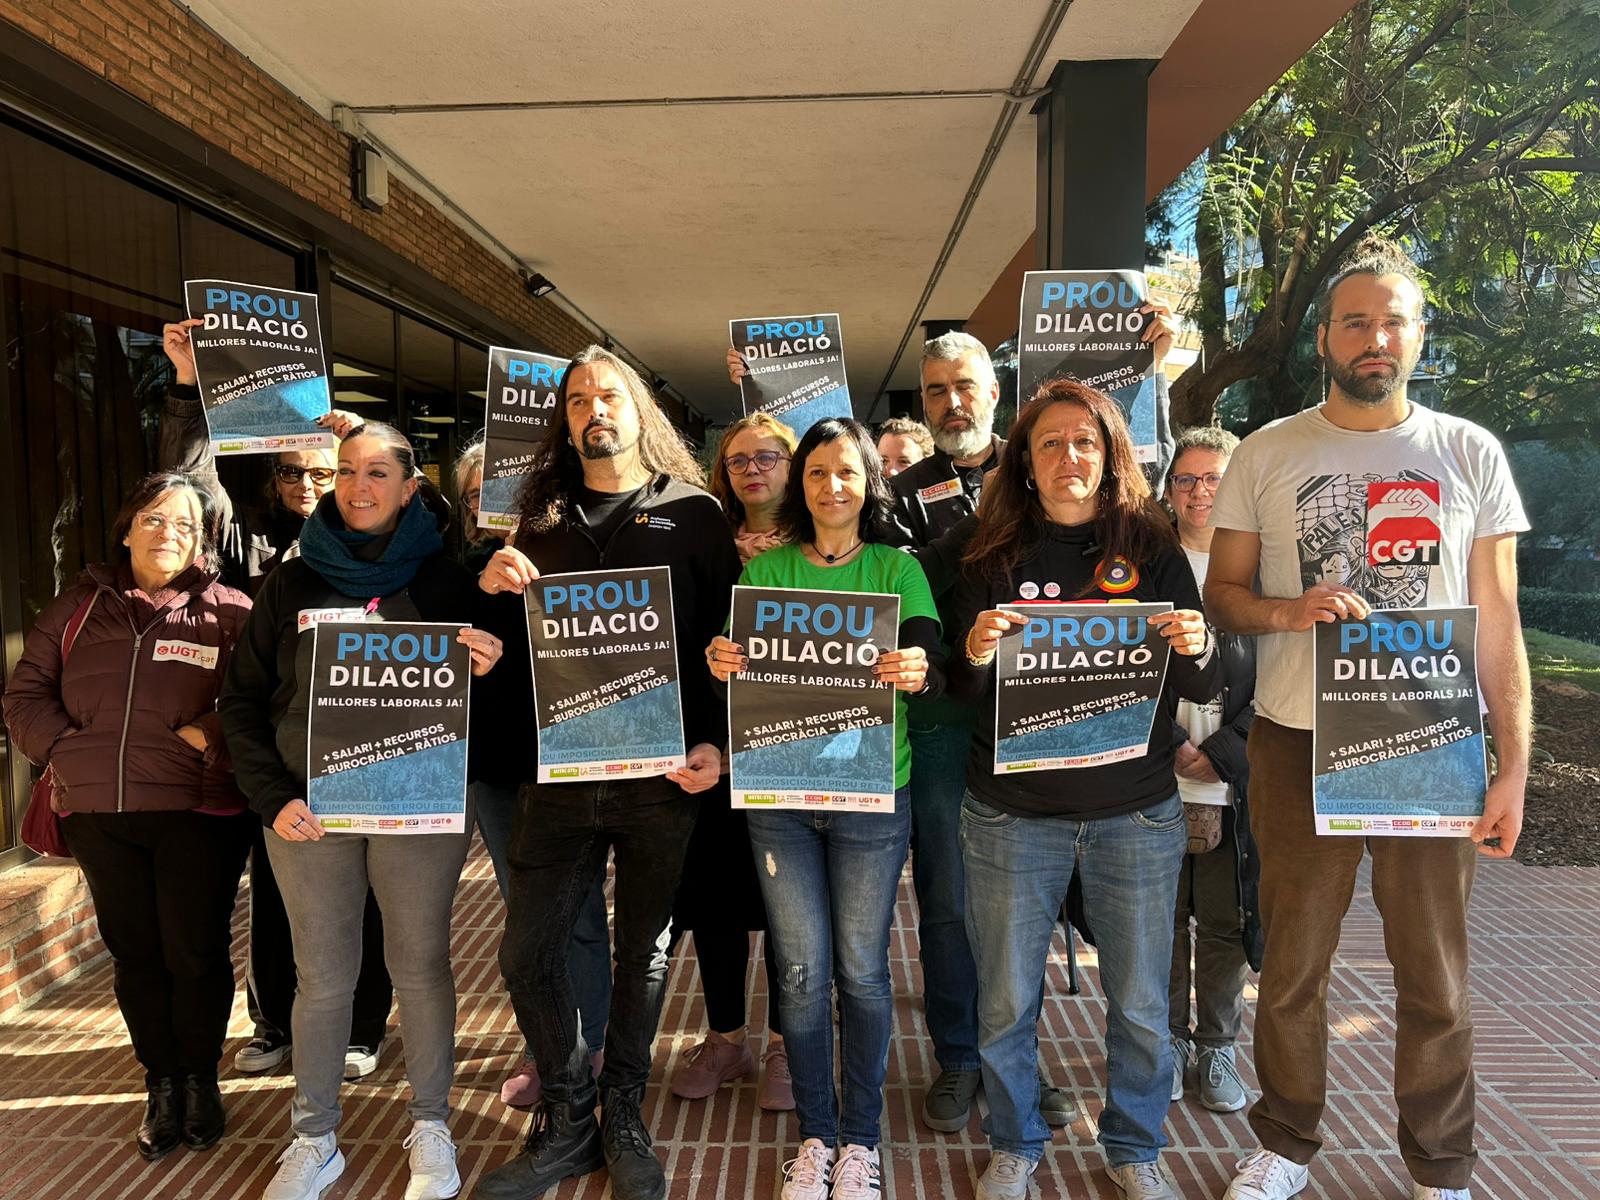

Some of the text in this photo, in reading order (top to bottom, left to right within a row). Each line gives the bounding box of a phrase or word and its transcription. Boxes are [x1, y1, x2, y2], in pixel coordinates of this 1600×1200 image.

[206, 288, 300, 319] PROU
[1042, 281, 1139, 309] PROU
[203, 313, 308, 339] DILACIÓ
[746, 319, 824, 342] PROU
[1034, 307, 1144, 334] DILACIÓ
[197, 338, 318, 354] MILLORES LABORALS JA!
[744, 334, 832, 362] DILACIÓ
[1025, 343, 1076, 353] MILLORES
[1079, 342, 1132, 352] LABORALS
[283, 368, 318, 382] RÀTIOS
[783, 357, 825, 370] LABORALS
[827, 355, 839, 365] JA!
[217, 375, 249, 393] SALARI
[255, 362, 306, 379] RECURSOS
[813, 381, 840, 399] RÀTIOS
[1108, 372, 1146, 392] RÀTIOS
[760, 395, 787, 413] SALARI
[792, 375, 830, 398] RECURSOS
[492, 413, 541, 426] MILLORES
[1372, 539, 1438, 563] CGT
[543, 579, 651, 614] PROU
[542, 606, 660, 639] DILACIÓ
[755, 600, 875, 638] PROU
[1023, 616, 1147, 648] PROU
[337, 632, 449, 663] PROU
[1340, 619, 1455, 653] PROU
[537, 641, 671, 659] MILLORES LABORALS JA!
[748, 636, 880, 666] DILACIÓ
[1016, 644, 1153, 672] DILACIÓ
[330, 662, 455, 688] DILACIÓ
[1004, 669, 1159, 687] MILLORES LABORALS JA!
[1333, 649, 1461, 681] DILACIÓ
[556, 691, 592, 711] SALARI
[600, 666, 656, 694] RECURSOS
[629, 675, 669, 697] RÀTIOS
[736, 671, 889, 690] MILLORES LABORALS JA!
[318, 697, 463, 708] MILLORES LABORALS JA!
[1104, 695, 1149, 713] RÀTIOS
[1322, 688, 1473, 702] MILLORES LABORALS JA!
[753, 719, 795, 737] SALARI
[805, 705, 869, 726] RECURSOS
[1019, 708, 1062, 727] SALARI
[1072, 690, 1137, 712] RECURSOS
[838, 715, 883, 733] RÀTIOS
[1338, 739, 1384, 757] SALARI
[1396, 716, 1460, 744] RECURSOS
[332, 742, 373, 761] SALARI
[383, 723, 446, 749] RECURSOS
[415, 732, 458, 753] RÀTIOS
[1430, 726, 1473, 749] RÀTIOS
